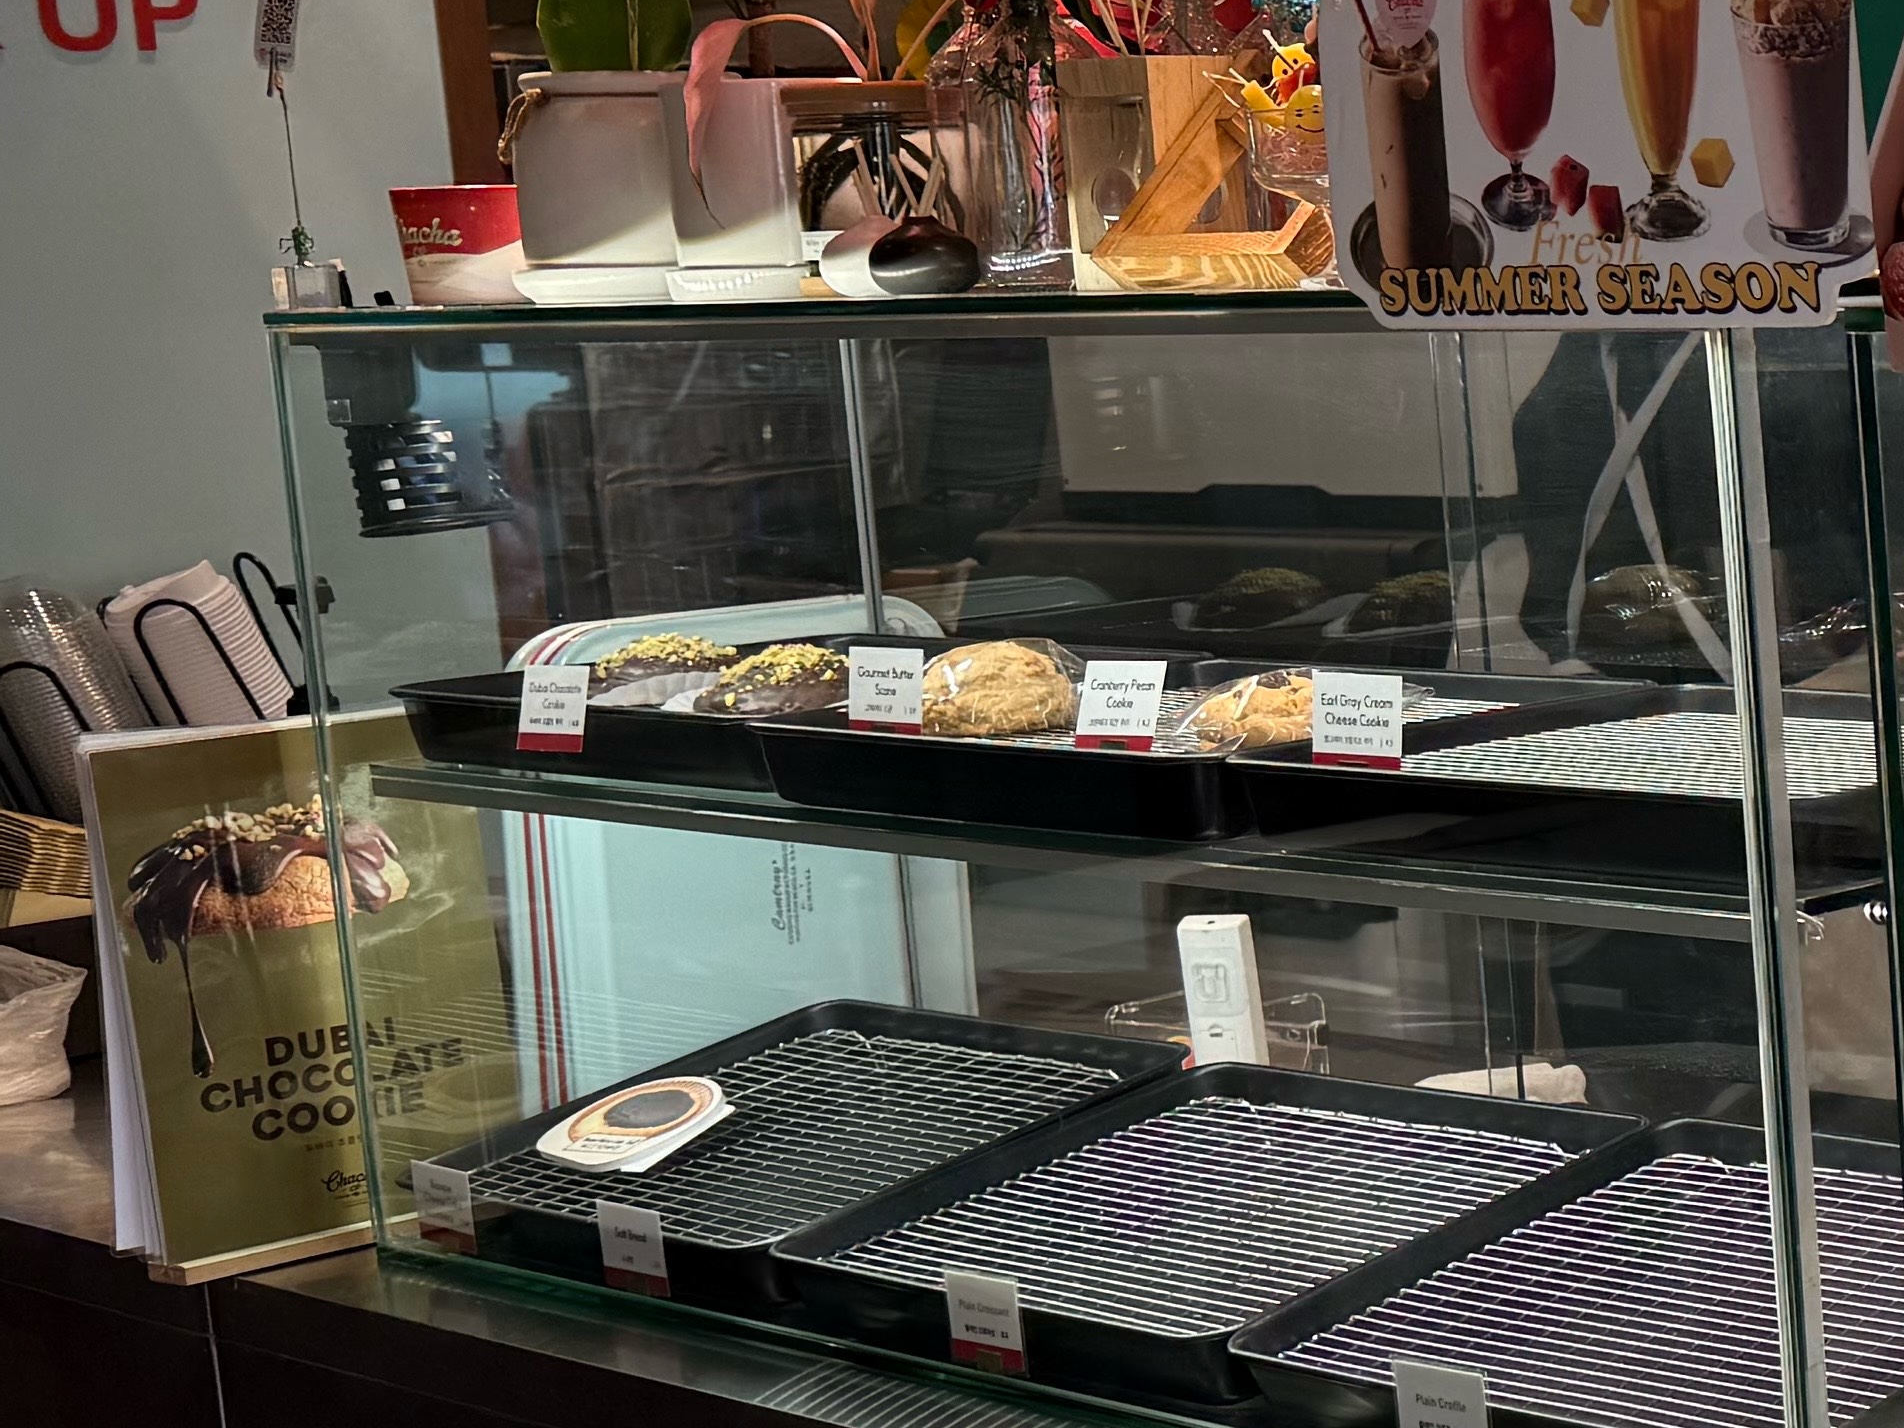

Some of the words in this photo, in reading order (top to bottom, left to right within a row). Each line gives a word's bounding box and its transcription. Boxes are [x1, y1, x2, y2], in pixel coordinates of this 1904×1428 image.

[1530, 218, 1643, 268] Fresh
[1380, 264, 1580, 318] SUMMER
[1599, 260, 1821, 316] SEASON
[200, 1037, 464, 1113] CHOCOATE
